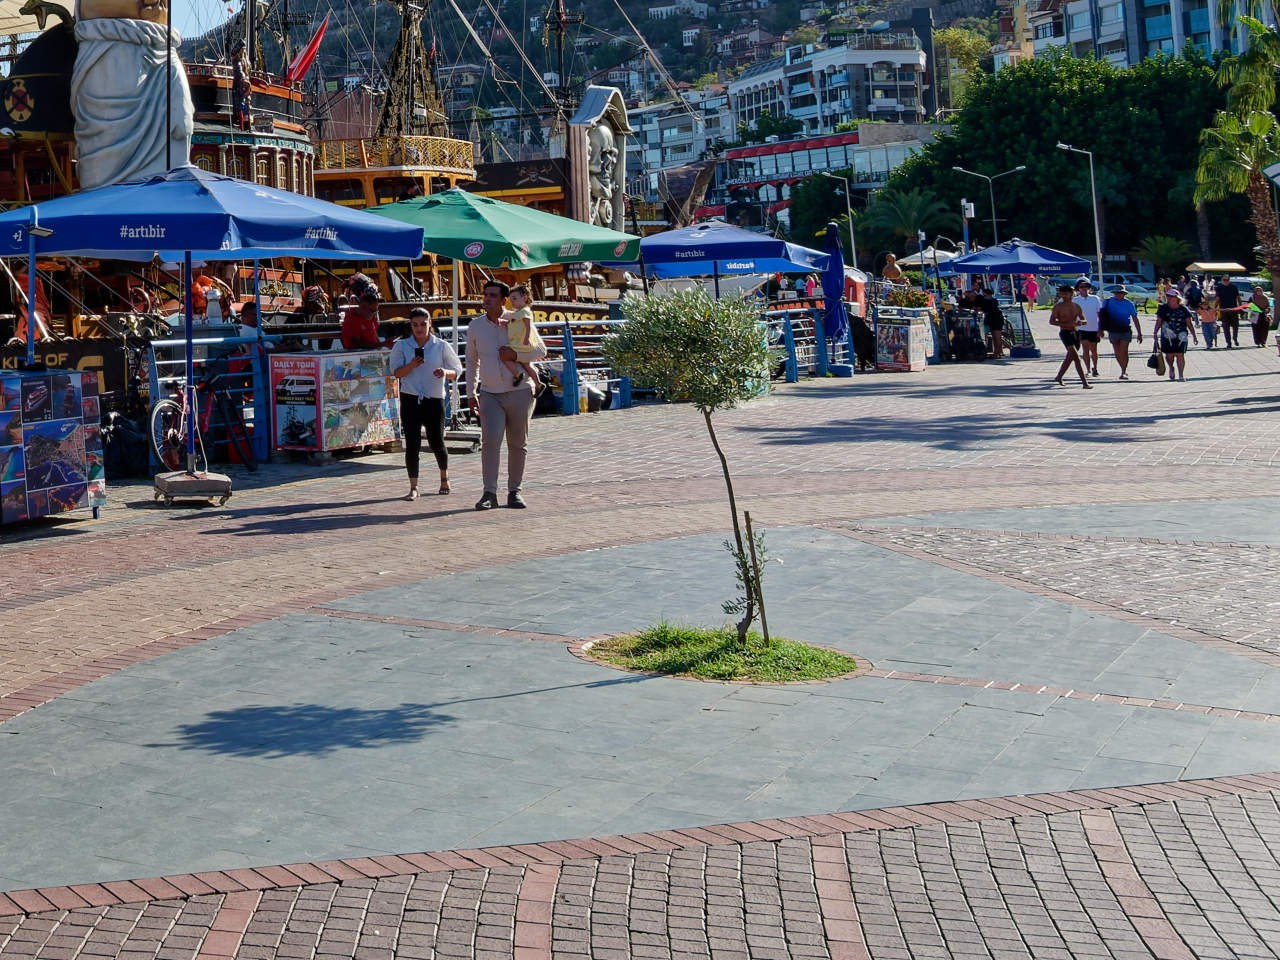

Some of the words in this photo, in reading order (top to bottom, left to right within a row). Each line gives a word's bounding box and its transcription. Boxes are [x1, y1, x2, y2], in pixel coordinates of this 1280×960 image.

[45, 352, 69, 367] OF
[274, 360, 294, 369] DAILY
[297, 361, 315, 369] TOUR
